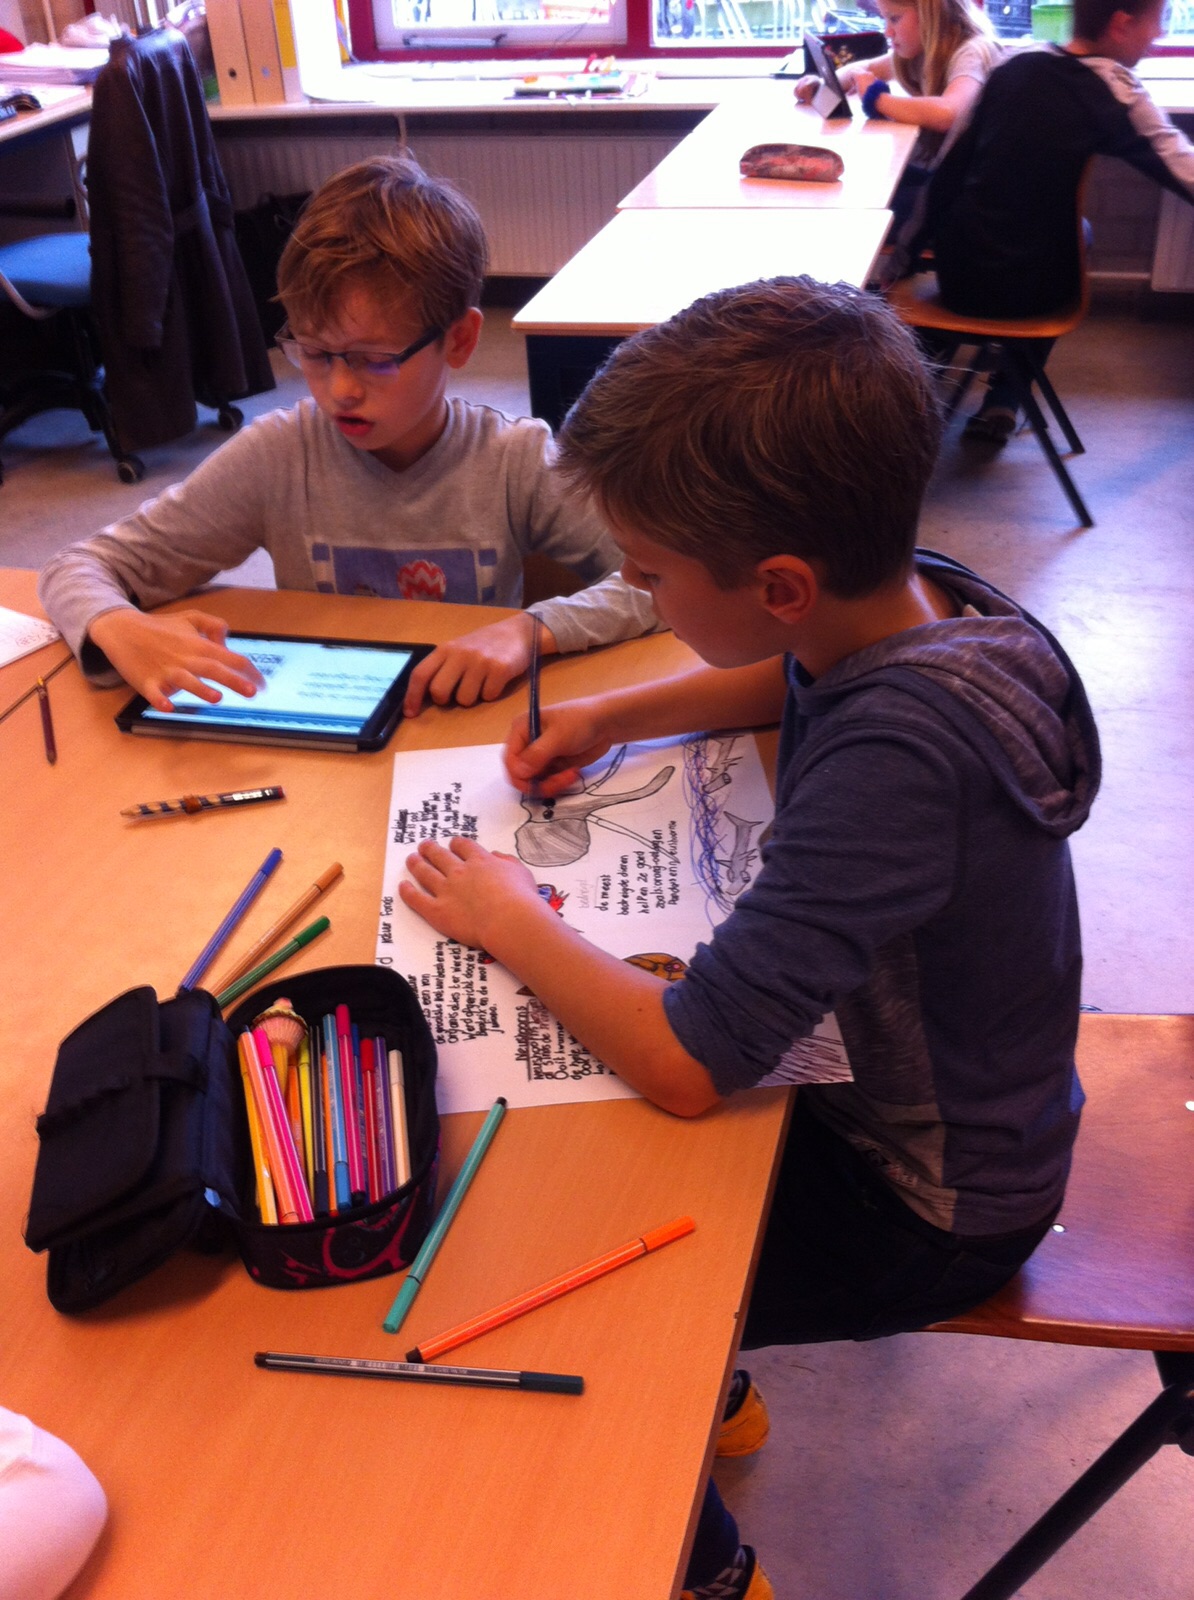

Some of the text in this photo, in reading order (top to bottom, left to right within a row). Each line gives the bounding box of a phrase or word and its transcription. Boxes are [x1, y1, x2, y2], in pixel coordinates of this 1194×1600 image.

[632, 850, 652, 869] goed
[594, 874, 612, 912] de meest
[616, 855, 635, 915] bedreigde dieren
[552, 1057, 569, 1080] Ooit
